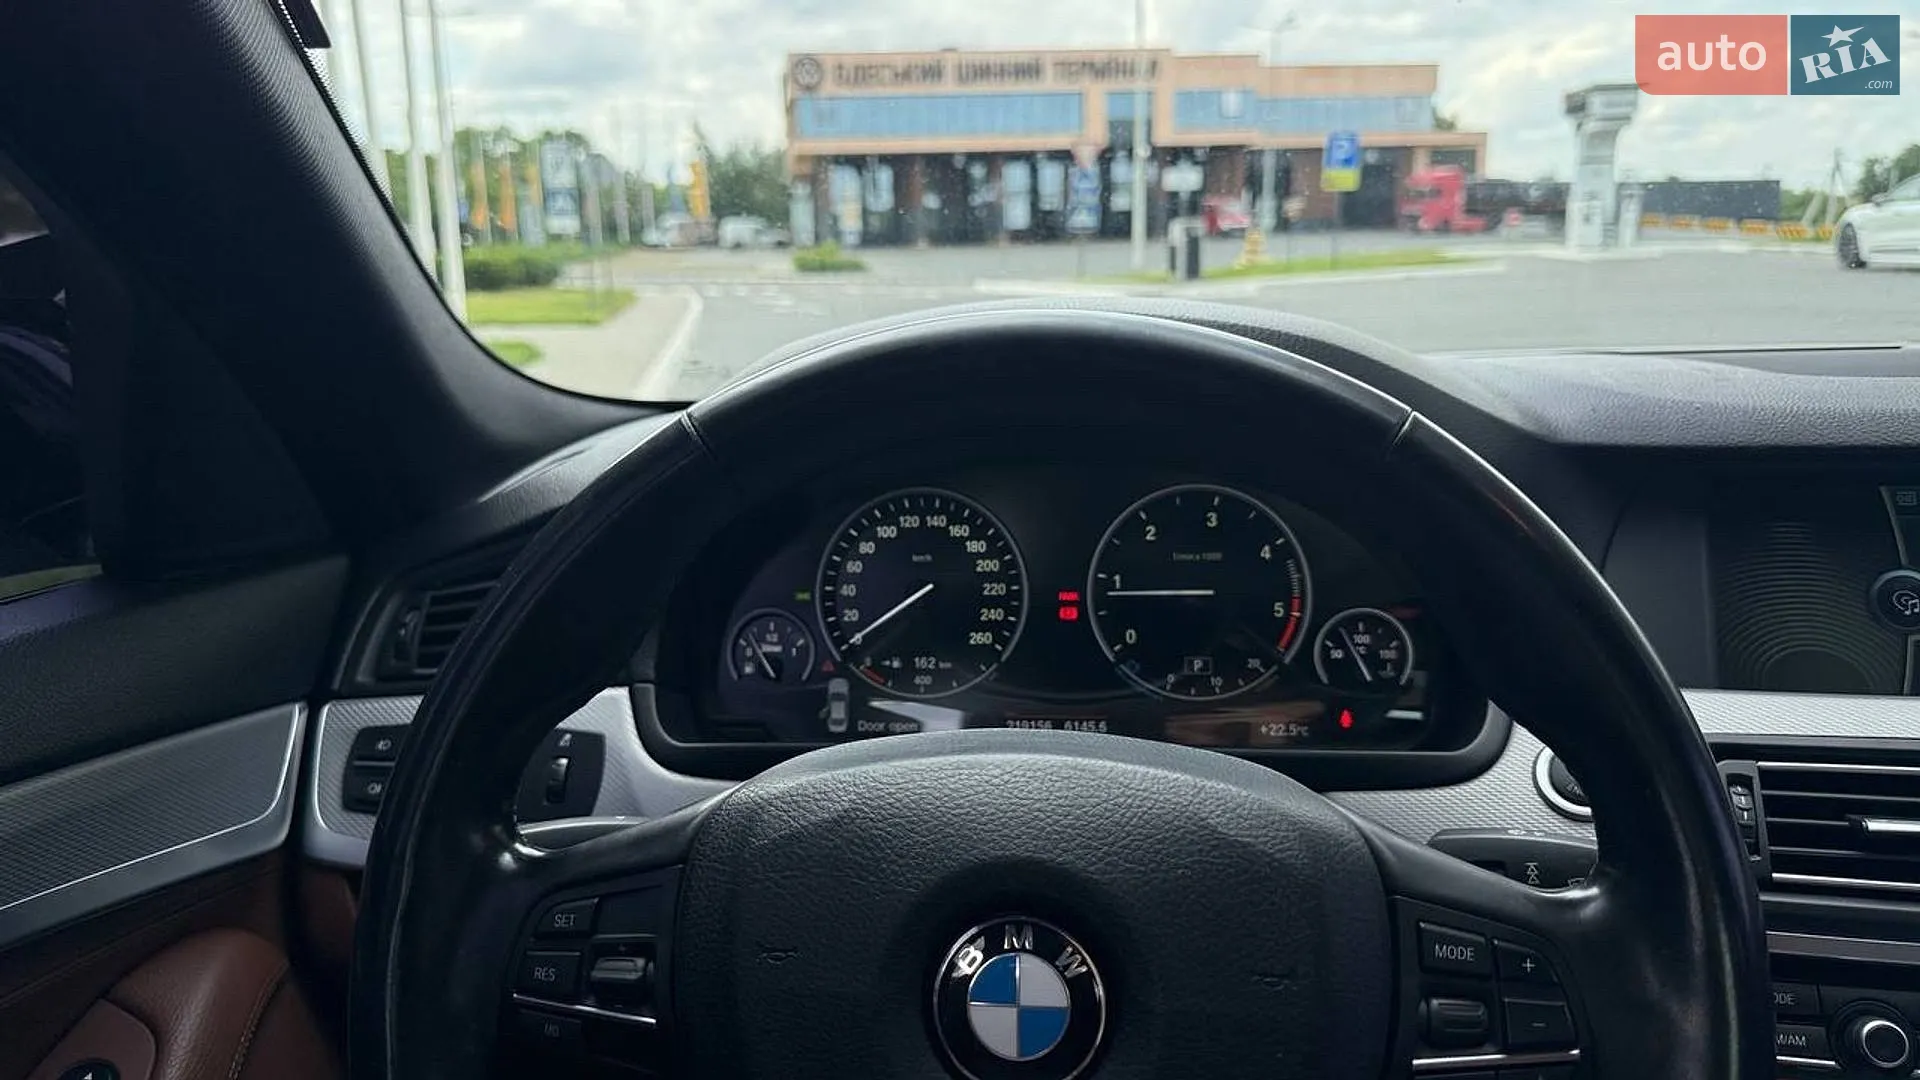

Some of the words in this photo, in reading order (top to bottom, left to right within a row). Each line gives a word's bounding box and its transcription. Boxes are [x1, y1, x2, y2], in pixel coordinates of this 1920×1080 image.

[898, 515, 920, 528] 120
[925, 515, 947, 528] 140
[1206, 511, 1219, 528] 3
[876, 525, 897, 538] 100
[948, 524, 970, 538] 160
[1145, 525, 1157, 541] 2
[858, 541, 876, 554] 80
[964, 540, 987, 553] 180
[1259, 544, 1272, 561] 4
[845, 560, 863, 573] 60
[975, 558, 1000, 573] 200
[1112, 574, 1122, 589] 1
[839, 583, 857, 597] 40
[982, 582, 1007, 596] 220
[843, 608, 860, 622] 20
[979, 607, 1005, 621] 240
[1273, 602, 1285, 618] 5
[968, 631, 994, 645] 260
[1125, 629, 1137, 645] 0
[1352, 633, 1371, 645] 100
[913, 656, 937, 670] 162
[1193, 659, 1204, 673] P
[1210, 676, 1224, 687] 10
[857, 719, 886, 732] Door
[553, 912, 577, 928] SET
[951, 924, 1090, 979] BMW
[1434, 943, 1475, 962] MODE
[533, 966, 557, 982] RES
